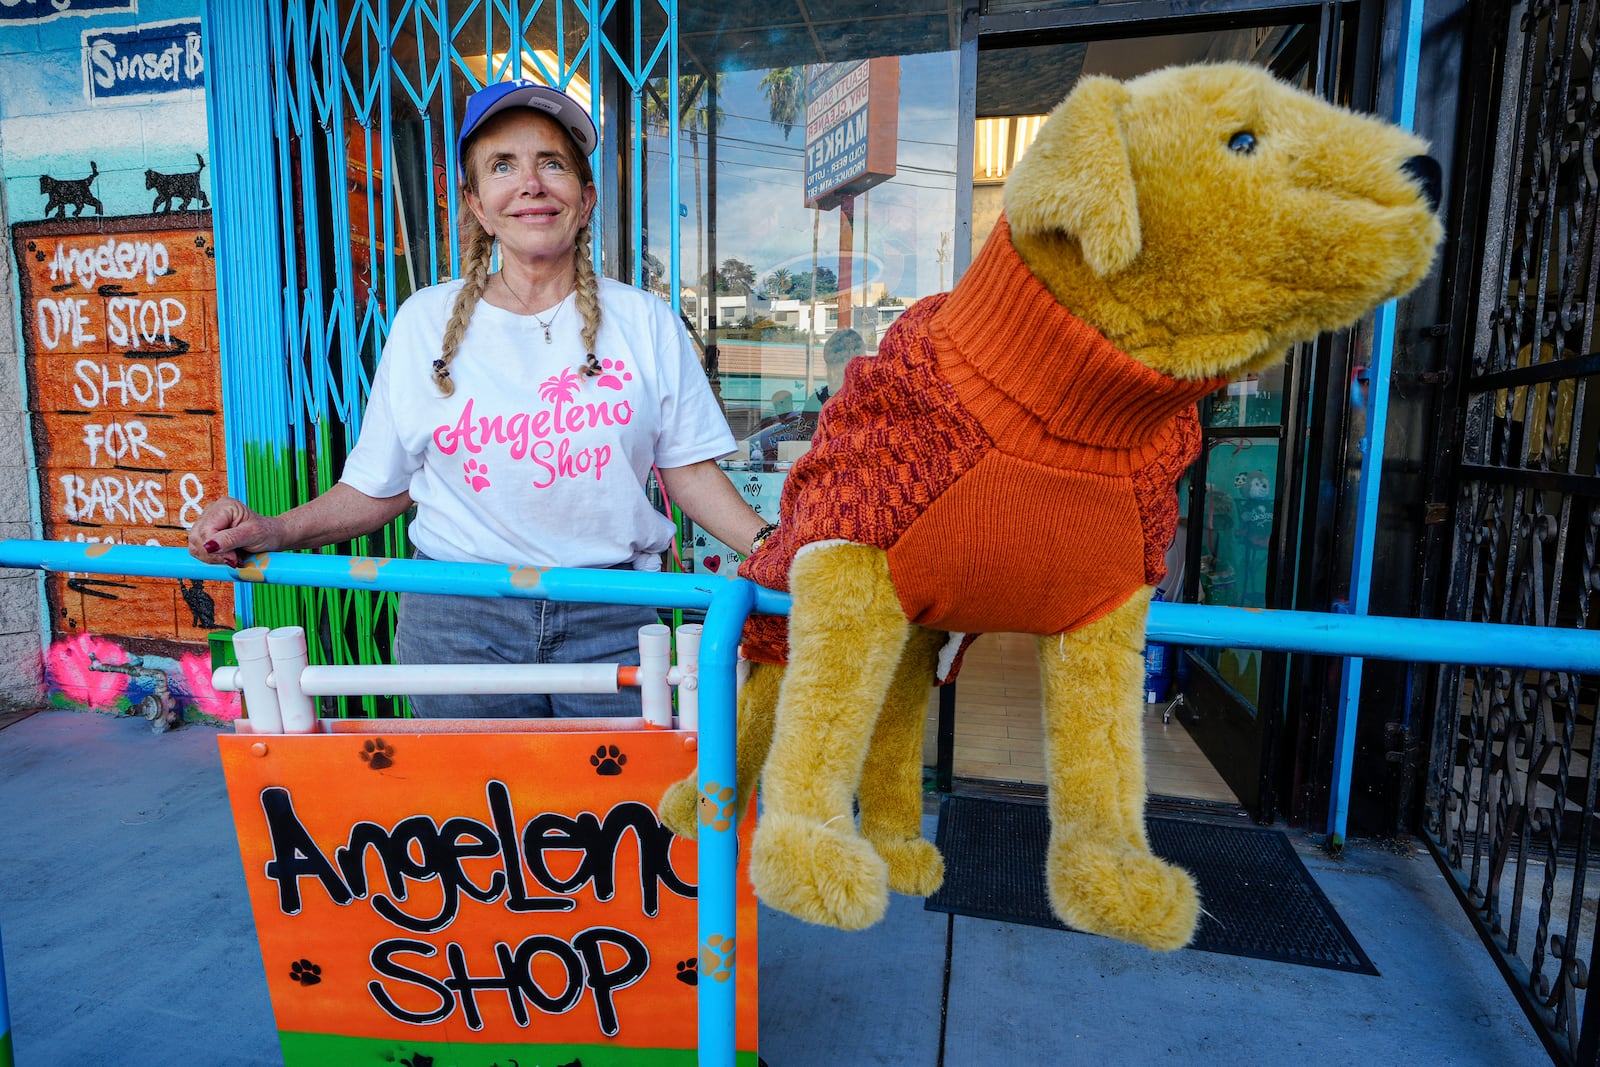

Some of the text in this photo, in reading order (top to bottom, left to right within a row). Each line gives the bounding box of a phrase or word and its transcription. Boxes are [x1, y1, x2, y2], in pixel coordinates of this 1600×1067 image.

[92, 39, 183, 88] Sunset
[48, 238, 169, 289] Angeleno
[107, 297, 186, 348] STOP
[73, 359, 181, 409] SHOP
[83, 420, 167, 466] FOR
[433, 395, 634, 460] Angeleno
[530, 438, 611, 489] Shop
[59, 474, 166, 524] BARKS
[368, 926, 651, 1037] SHOP
